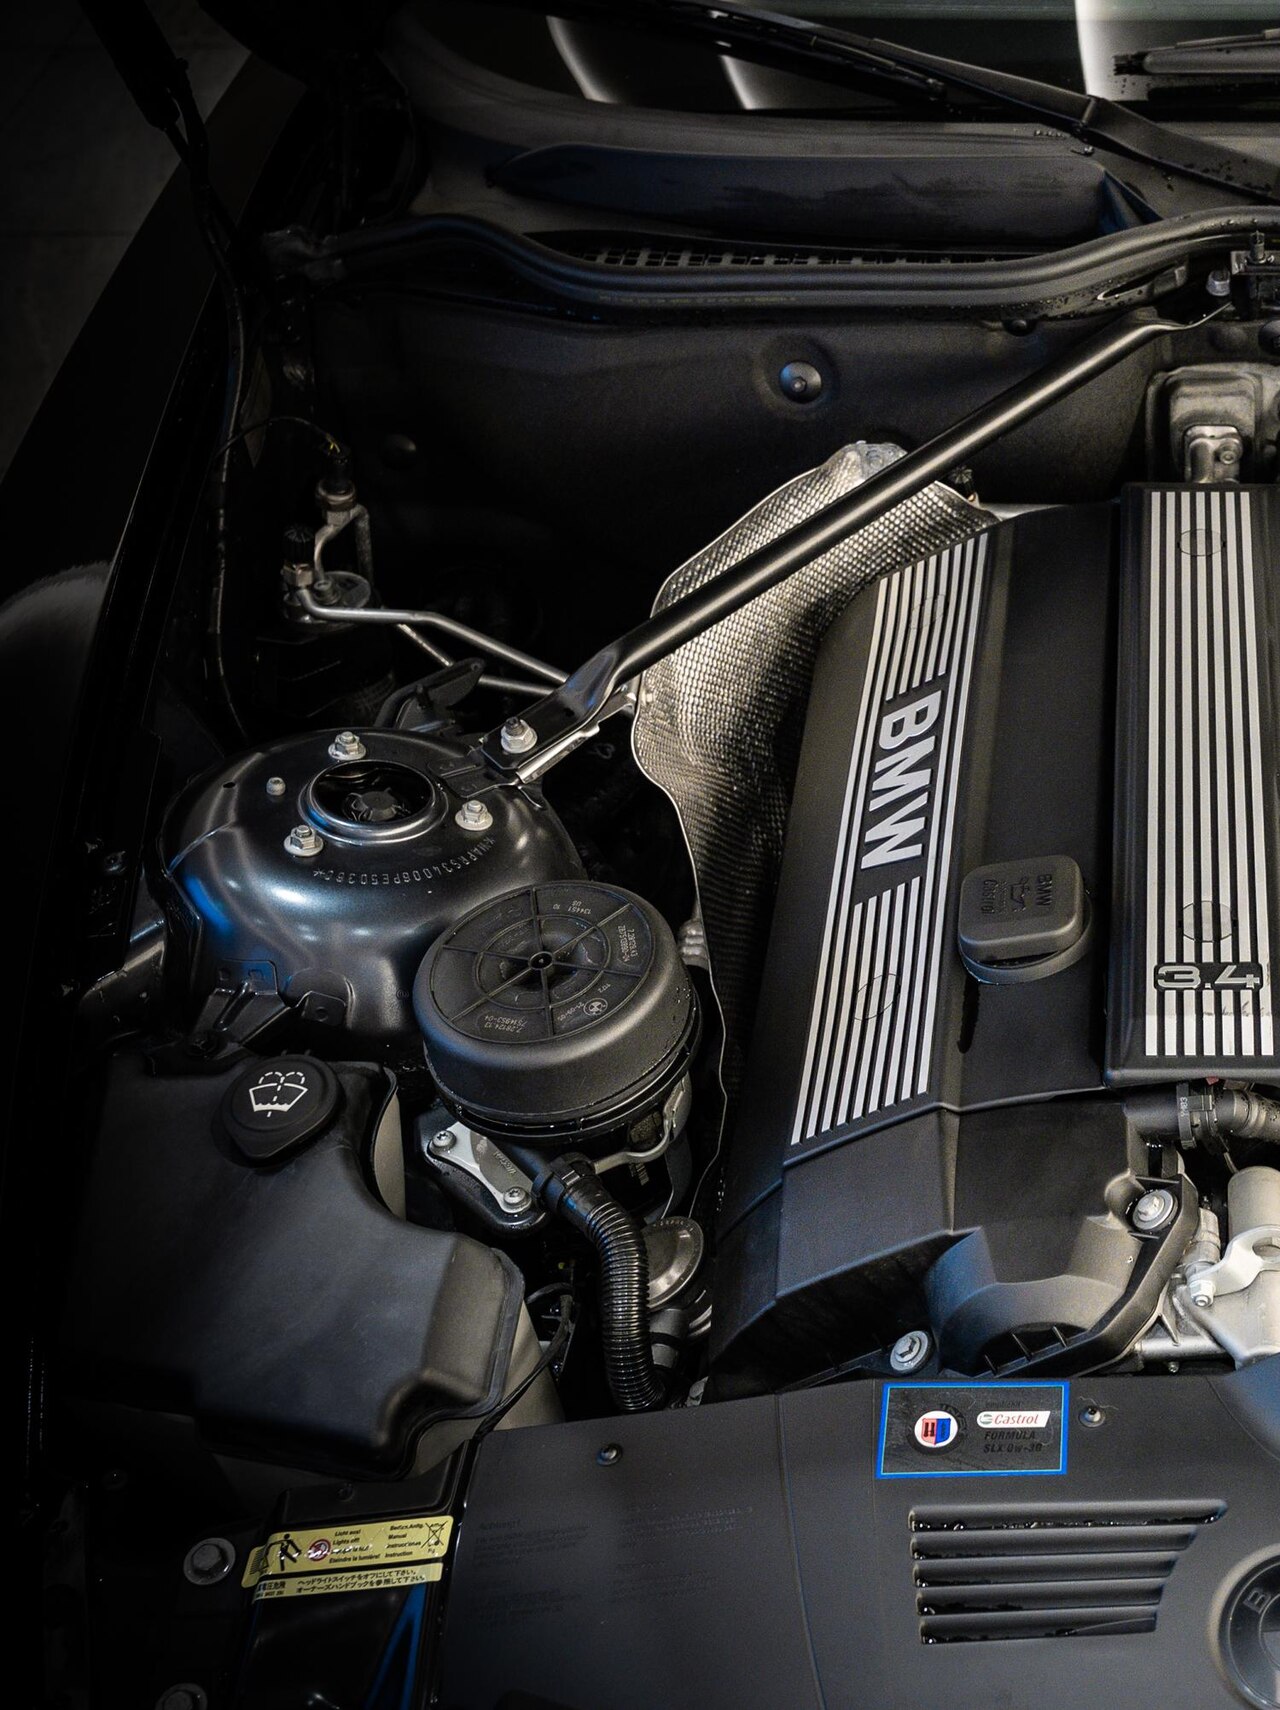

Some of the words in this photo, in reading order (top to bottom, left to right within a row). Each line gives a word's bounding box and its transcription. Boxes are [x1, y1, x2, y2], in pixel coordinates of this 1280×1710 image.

[861, 690, 942, 870] BMW
[1036, 873, 1053, 906] BMW
[1157, 964, 1260, 989] 3.4
[994, 1414, 1039, 1425] Castrol
[984, 1431, 1035, 1441] FORMULA
